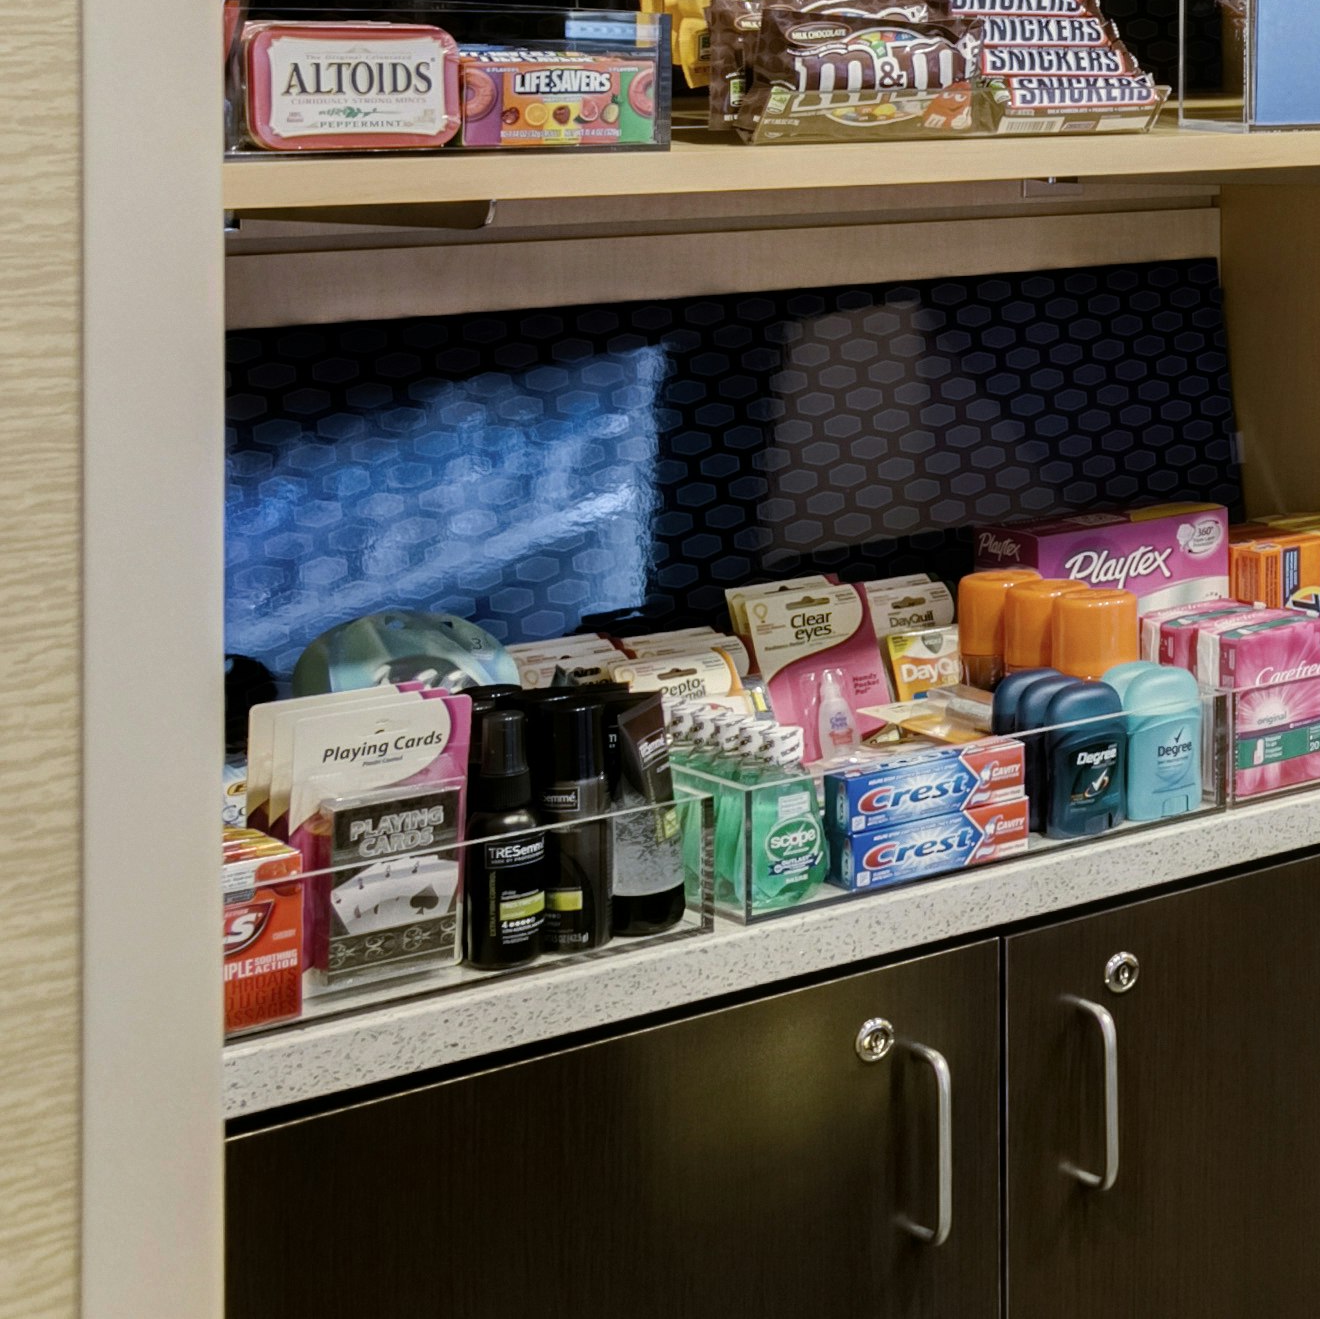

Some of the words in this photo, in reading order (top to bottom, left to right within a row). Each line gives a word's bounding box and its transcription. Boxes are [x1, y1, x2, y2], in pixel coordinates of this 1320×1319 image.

[791, 30, 809, 41] MILK
[808, 28, 847, 41] CHOCOLATE
[983, 17, 1102, 44] NICKERS
[988, 48, 1121, 75] SNICKERS
[281, 61, 433, 98] ALTOIDS
[290, 97, 350, 106] CURIOUSLY
[351, 96, 393, 106] STRONG
[394, 96, 427, 105] MINTS
[1016, 76, 1153, 105] SNICKERS
[319, 119, 402, 129] PEPPERMINT
[977, 532, 1021, 562] Playtex
[1064, 545, 1174, 590] Playtex
[790, 610, 833, 629] Clear
[888, 609, 935, 629] DayQuil
[794, 622, 834, 643] eyes
[660, 677, 705, 698] Pepto-
[1256, 711, 1288, 727] original
[322, 741, 390, 764] Playing
[393, 730, 444, 751] Cards
[1076, 747, 1118, 766] Degree
[1157, 741, 1193, 758] Degree
[1309, 740, 1320, 752] 20
[992, 763, 1021, 778] CAVITY
[857, 772, 972, 815] Crest
[349, 804, 445, 842] PLAYING
[996, 816, 1026, 830] CAVITY
[358, 825, 435, 858] CARDS
[770, 828, 817, 848] scope
[862, 827, 976, 871] Crest
[254, 948, 299, 965] SOOTHING
[254, 957, 299, 976] ACTION
[224, 958, 254, 981] IPLE
[230, 969, 297, 996] HROATS
